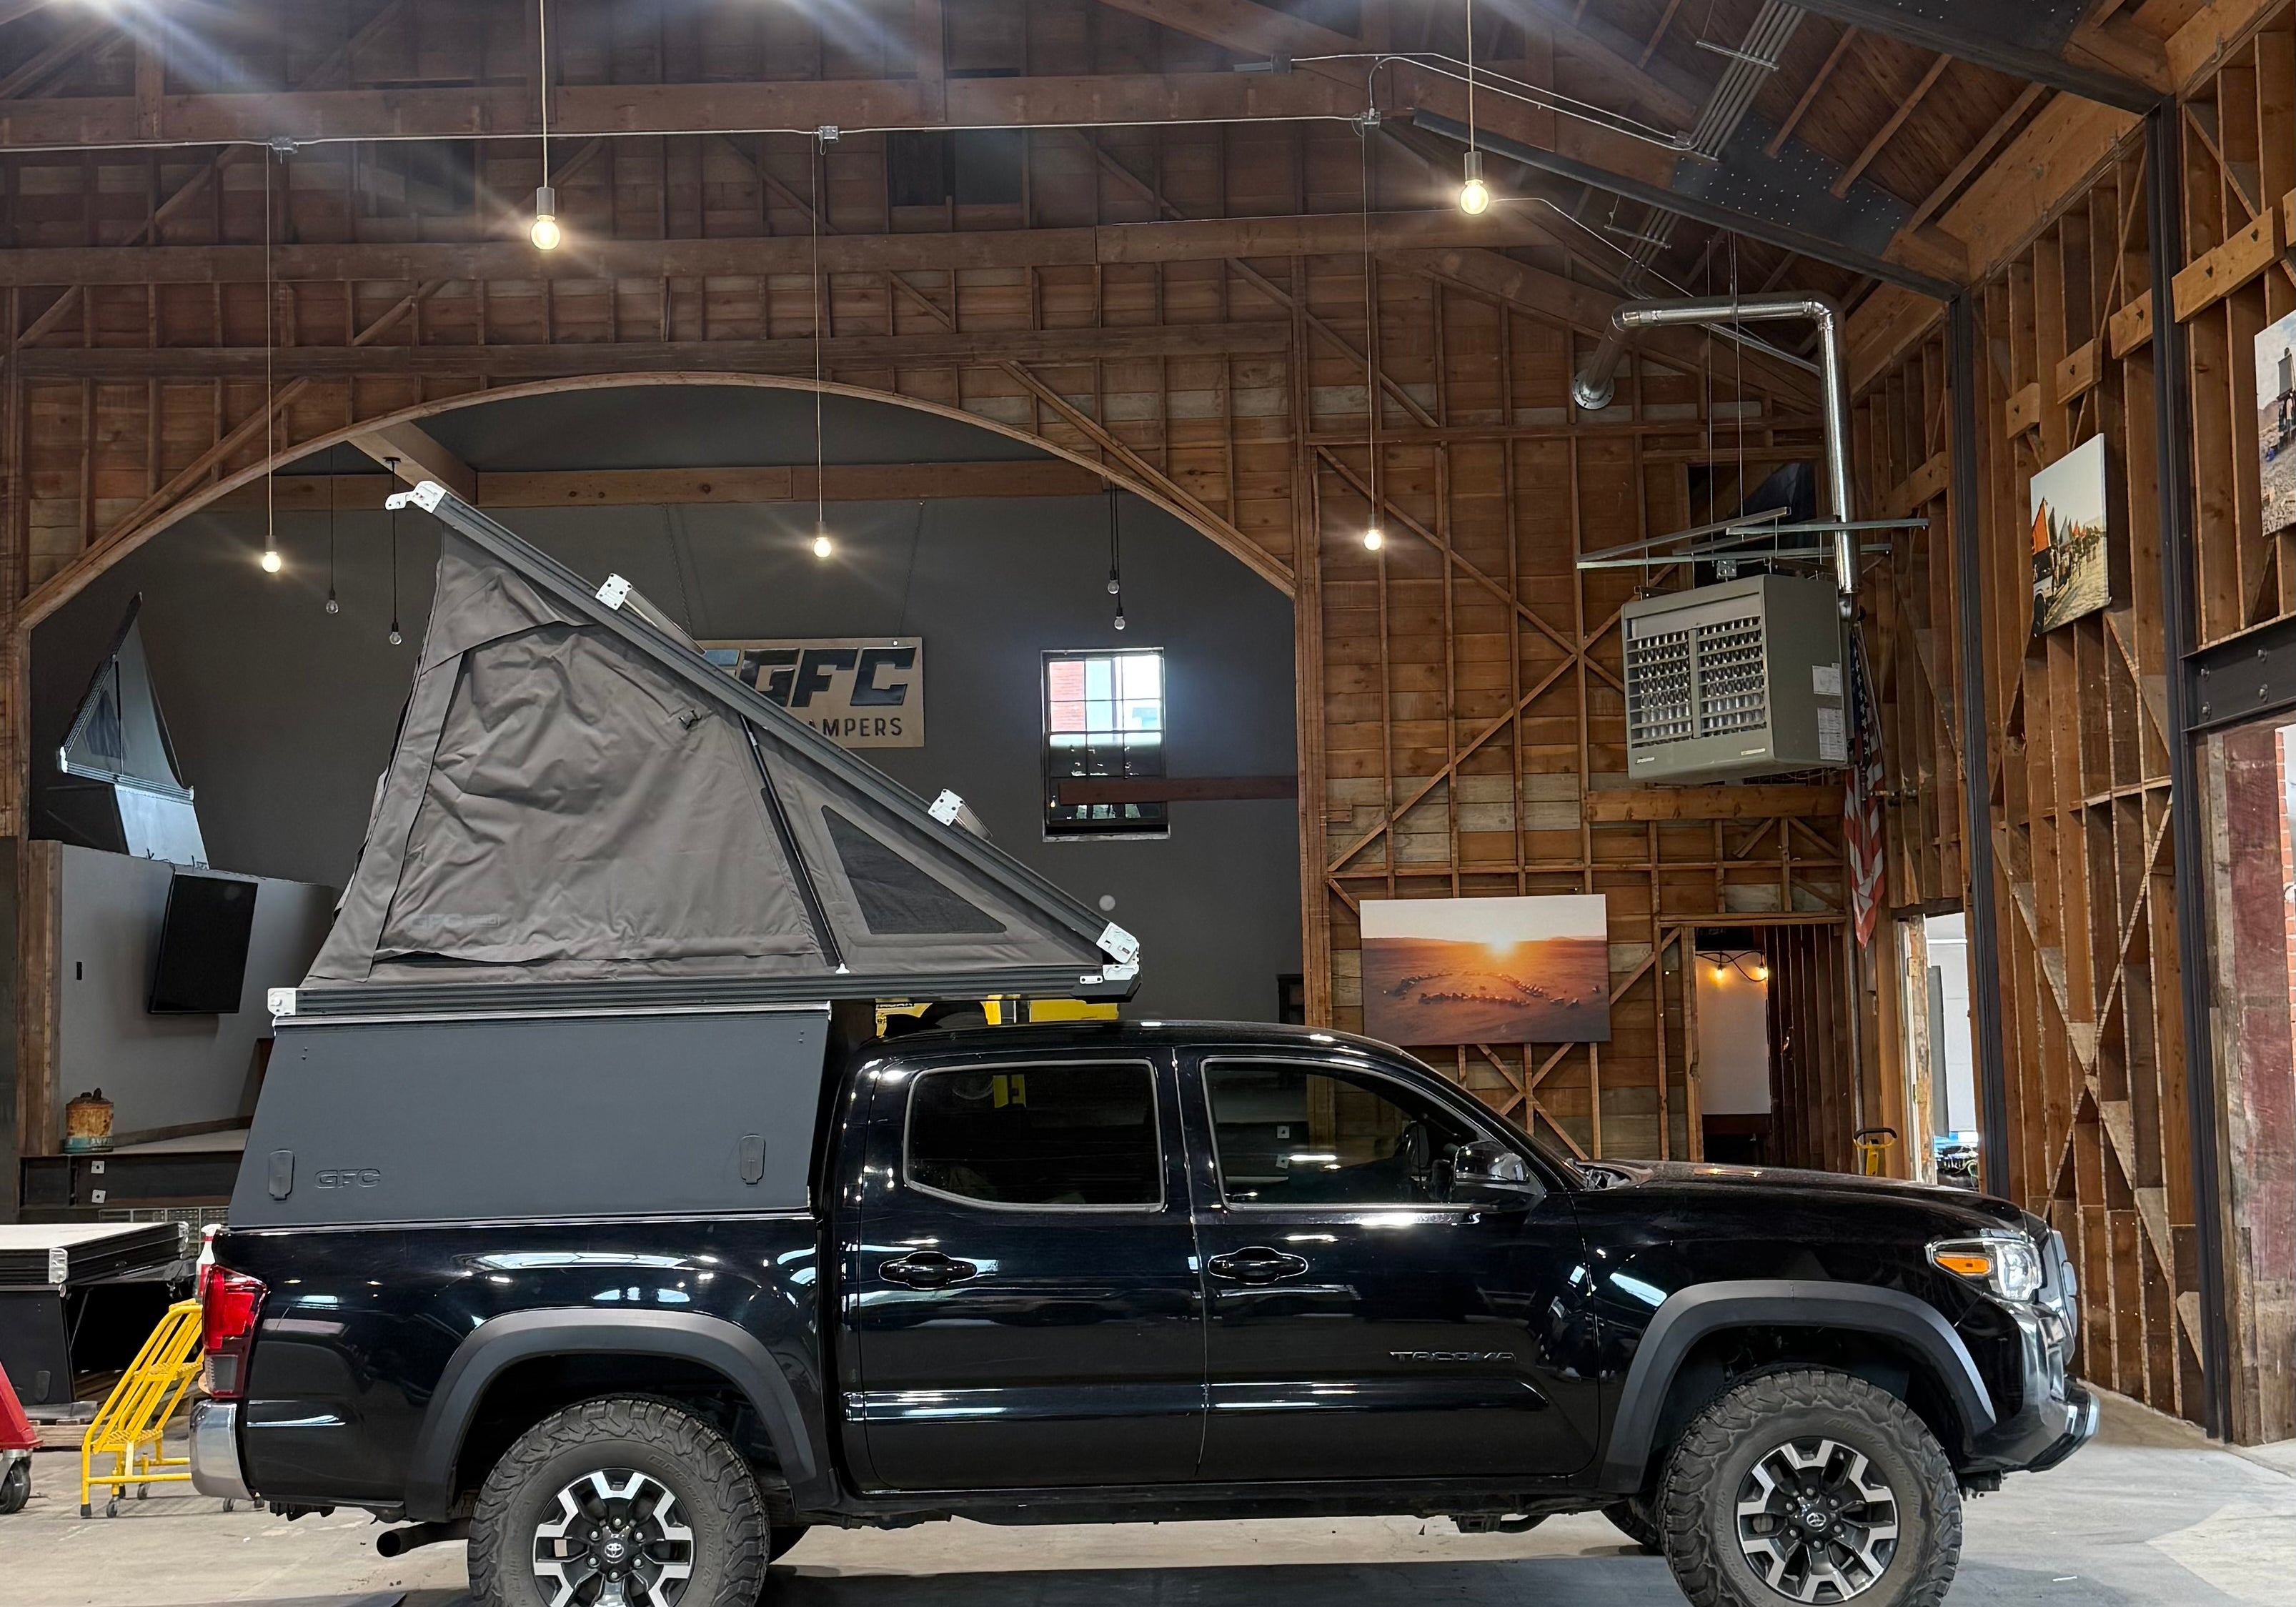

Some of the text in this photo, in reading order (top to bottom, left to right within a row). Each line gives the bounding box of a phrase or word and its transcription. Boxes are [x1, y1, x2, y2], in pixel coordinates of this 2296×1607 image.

[740, 647, 917, 707] GFC
[314, 1168, 381, 1189] GFC
[1389, 1351, 1517, 1362] TACOMA
